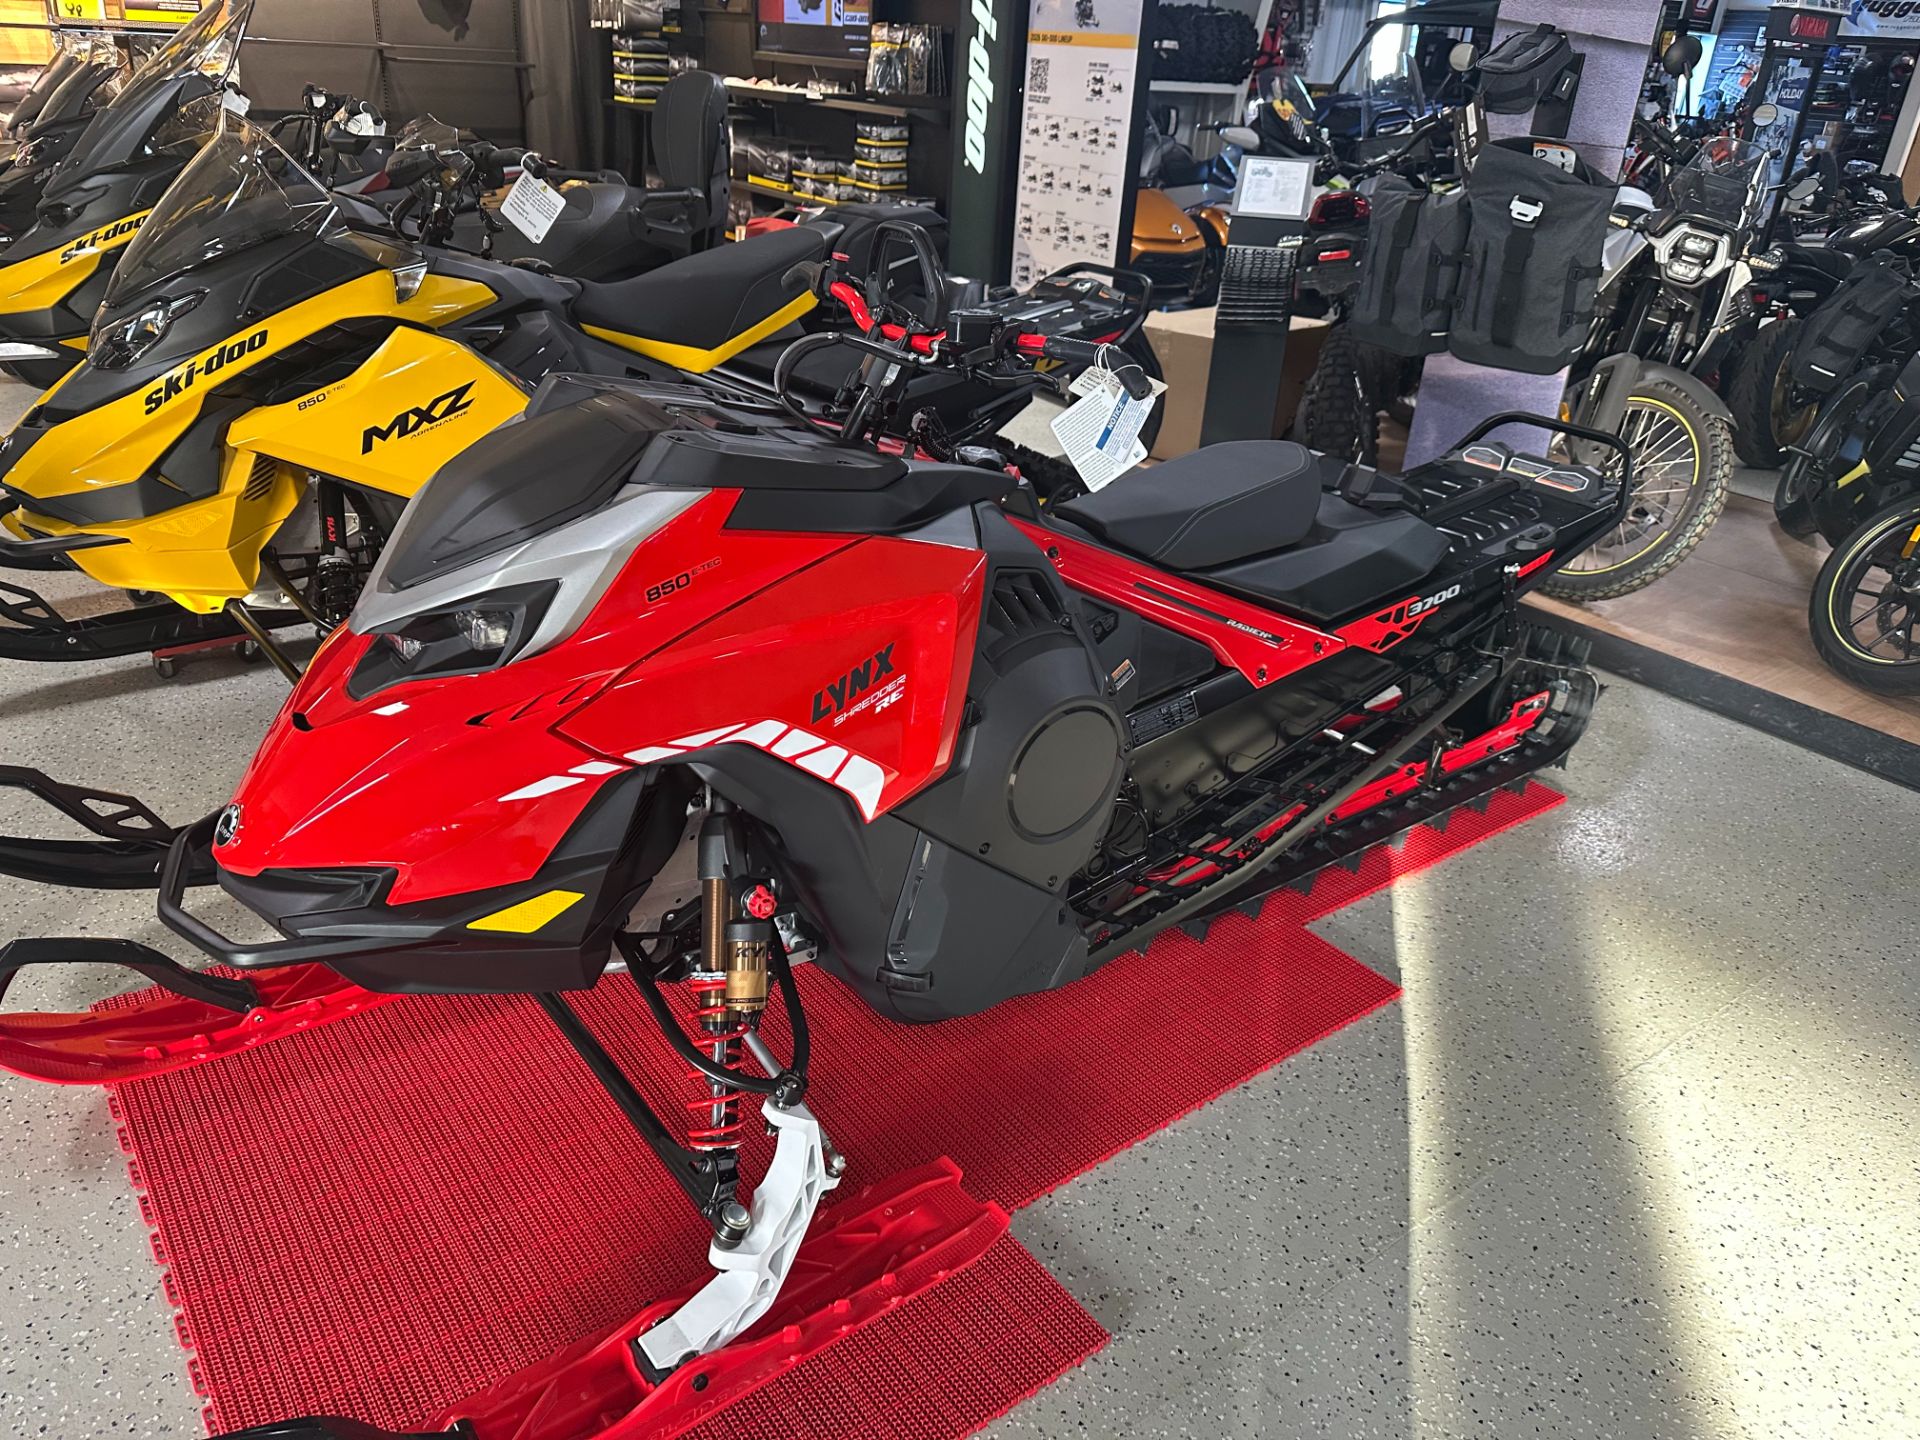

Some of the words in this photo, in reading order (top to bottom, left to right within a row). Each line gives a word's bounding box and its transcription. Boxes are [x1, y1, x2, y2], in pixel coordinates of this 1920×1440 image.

[1799, 15, 1829, 38] YAMAHA
[964, 0, 998, 174] i-doo
[1779, 88, 1804, 99] HOLIDAY
[297, 392, 326, 412] 850
[361, 379, 479, 455] MXZ
[1106, 401, 1125, 431] NOTICE
[410, 410, 469, 440] ADRENALINE
[646, 573, 691, 602] 850
[691, 557, 721, 577] E-TEC
[1408, 584, 1461, 616] 3700
[811, 642, 895, 725] LYNX
[833, 674, 906, 727] SHREDDER
[875, 686, 905, 713] RE
